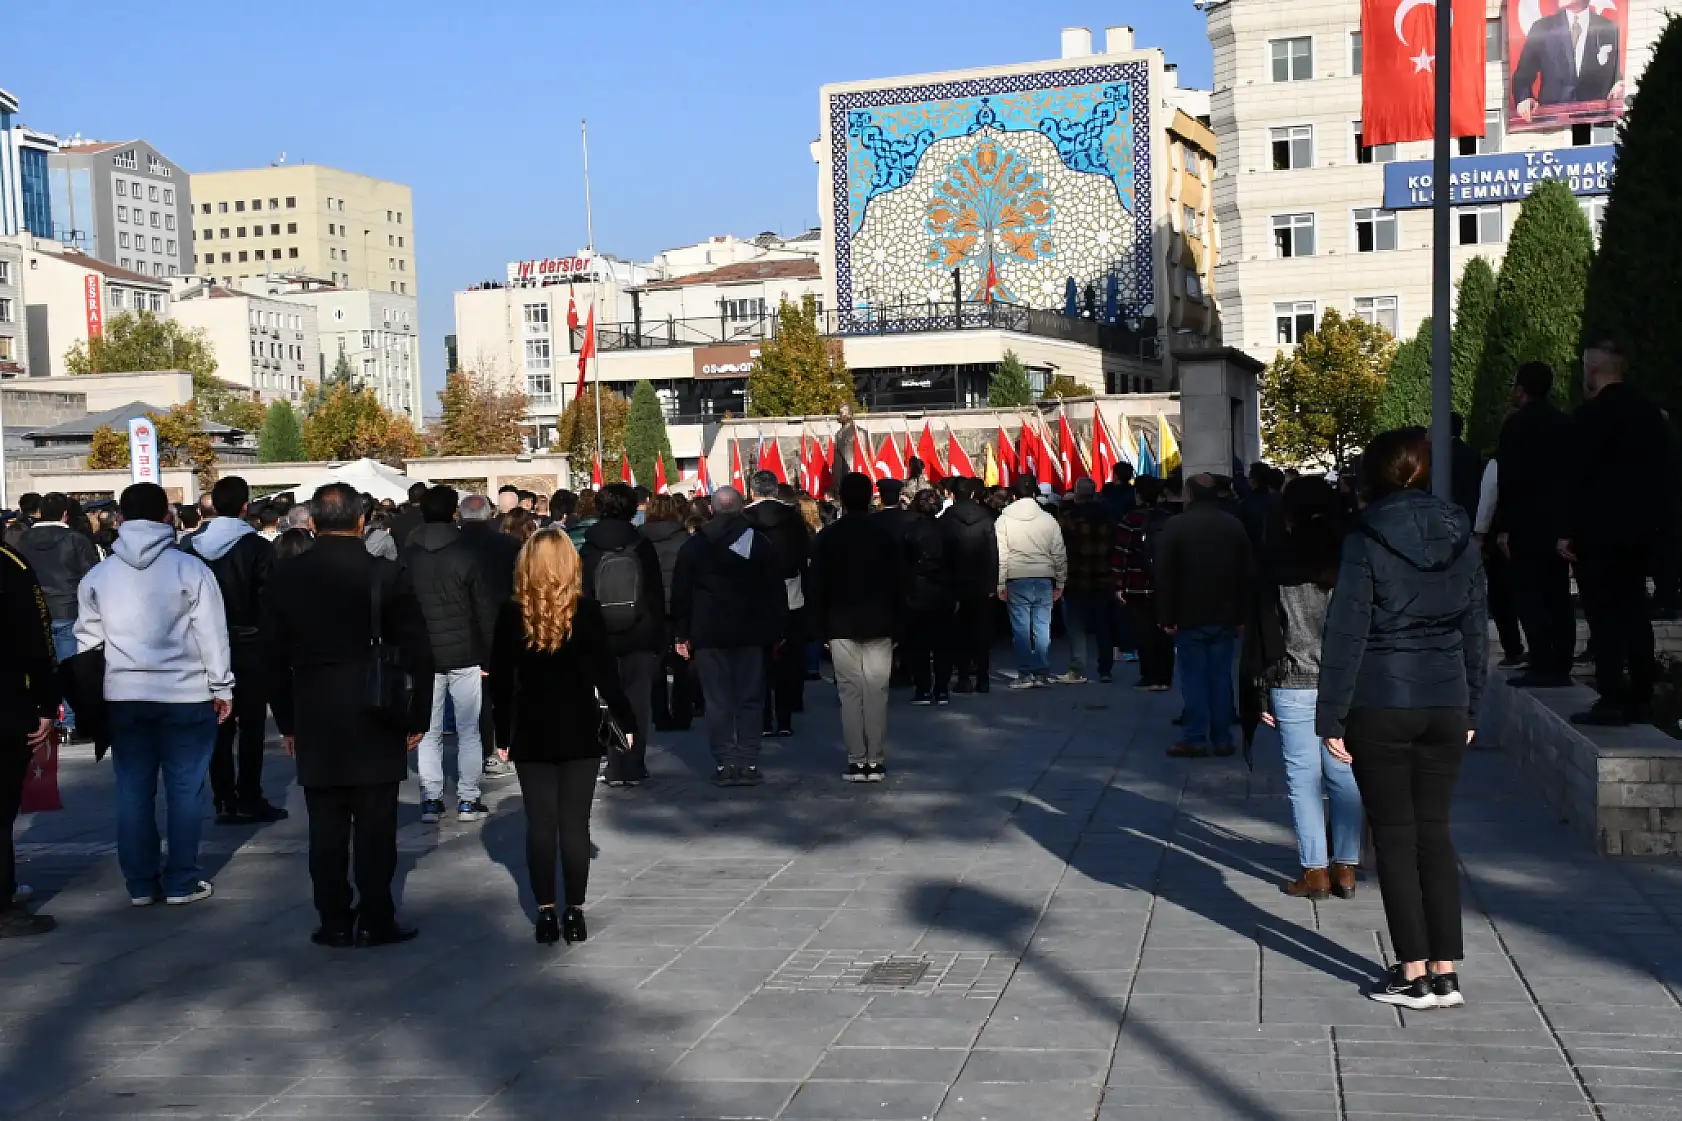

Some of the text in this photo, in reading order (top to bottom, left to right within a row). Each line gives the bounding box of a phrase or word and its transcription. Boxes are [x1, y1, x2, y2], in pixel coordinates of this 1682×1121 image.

[1524, 152, 1559, 166] T.C.
[1408, 168, 1520, 189] KOASİNAN
[1460, 180, 1543, 200] EMNİYE
